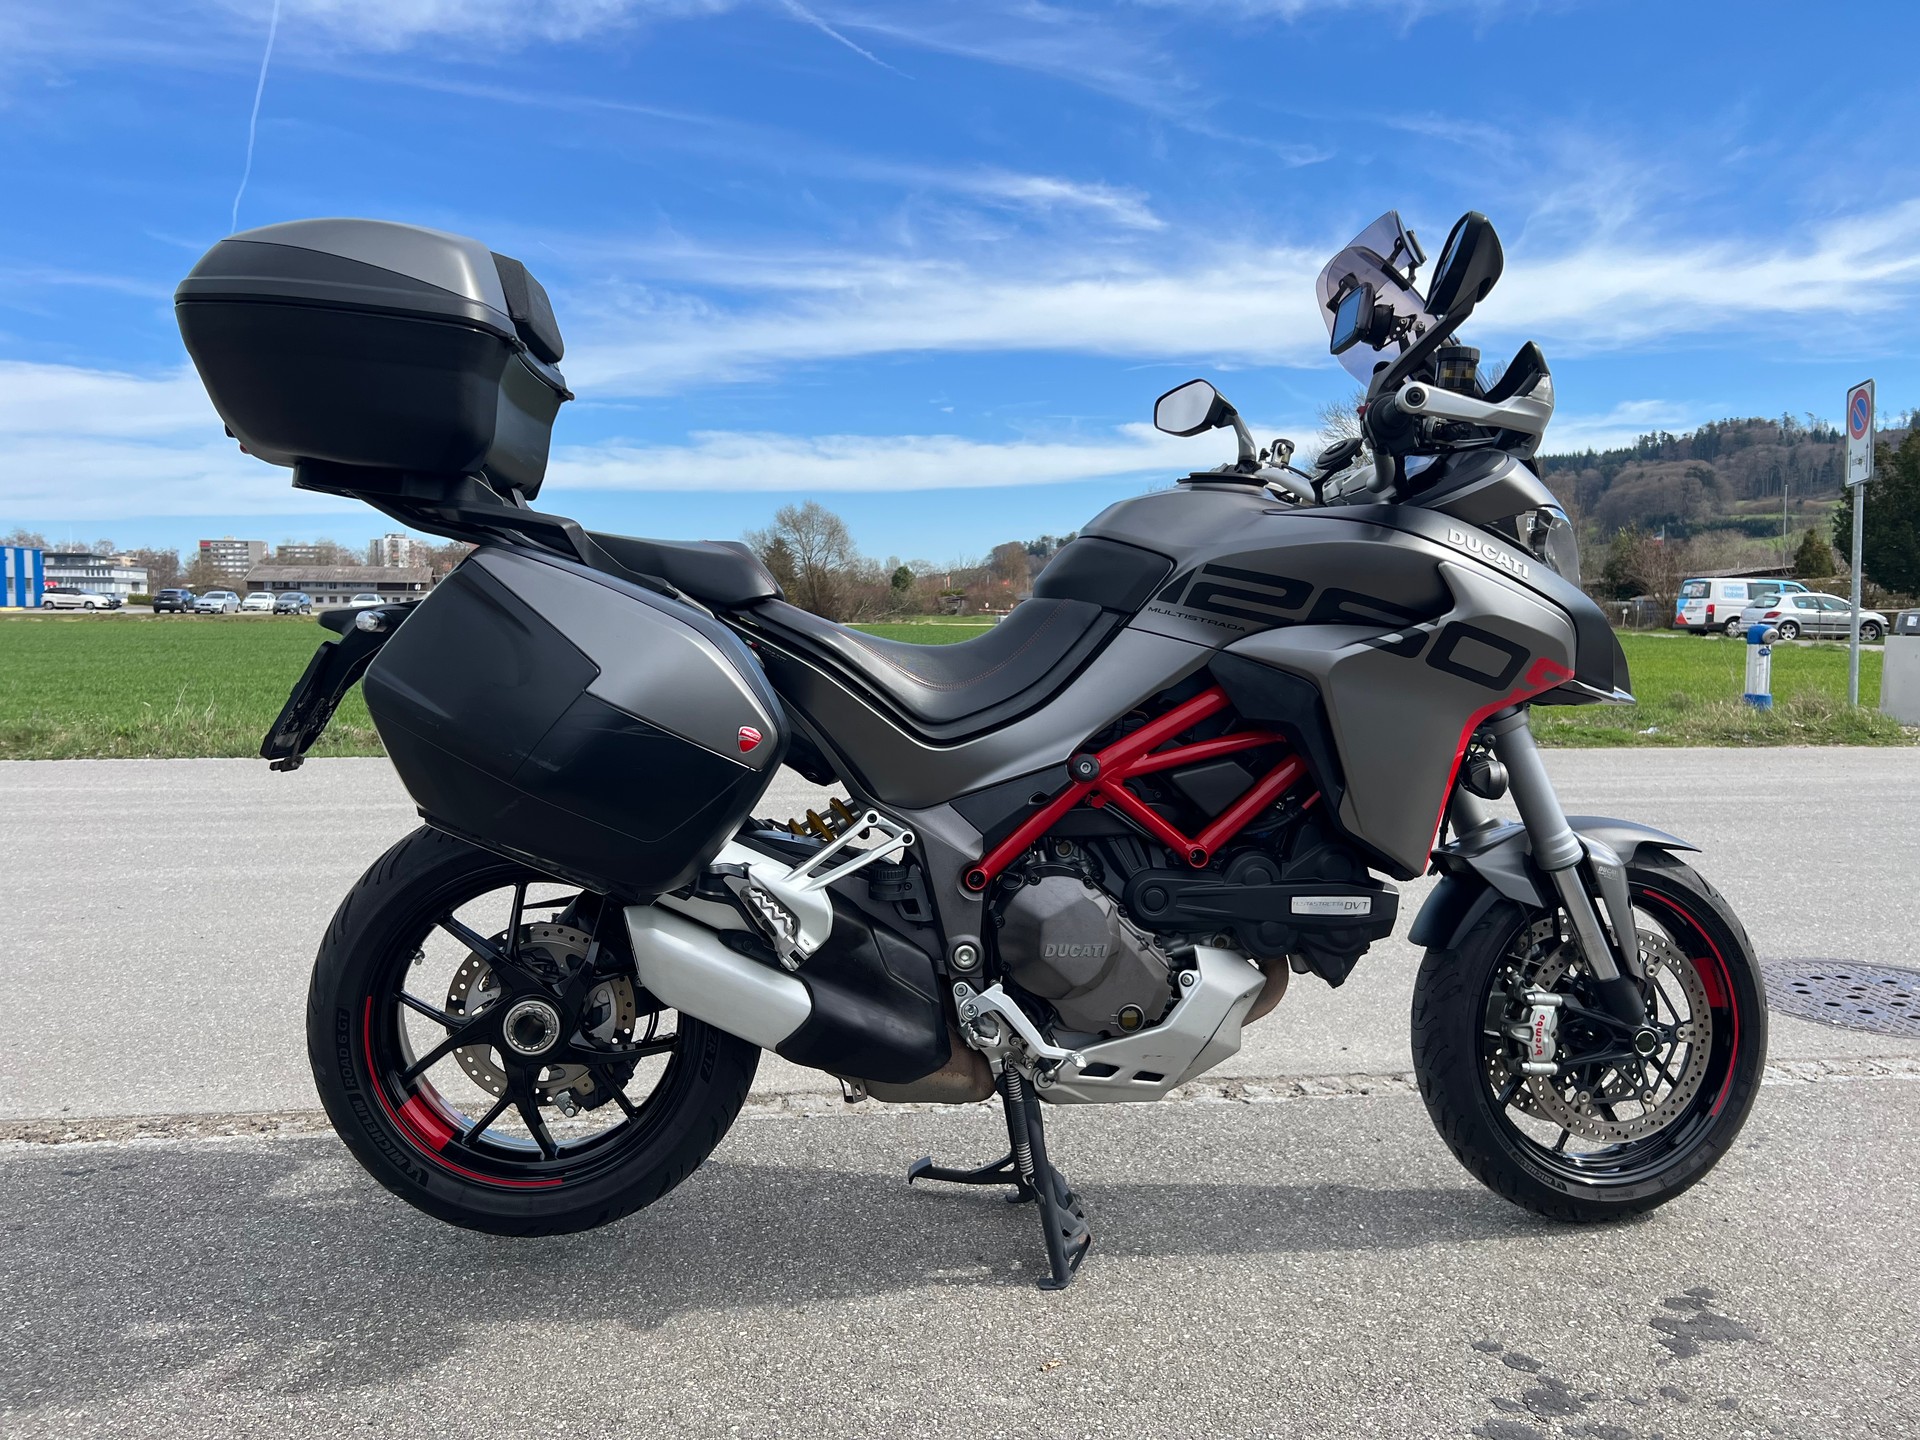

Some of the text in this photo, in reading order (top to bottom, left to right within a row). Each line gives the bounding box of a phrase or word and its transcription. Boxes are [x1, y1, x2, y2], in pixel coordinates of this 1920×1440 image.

[1448, 528, 1529, 579] DUCATI
[1148, 606, 1246, 633] MULTISTRADA
[1344, 901, 1370, 910] DVT
[1044, 943, 1108, 958] DUCATI
[338, 1012, 350, 1032] GT
[1534, 1014, 1546, 1056] brembo
[338, 1048, 357, 1088] ROAD
[703, 1030, 718, 1078] ZR 17
[351, 1097, 409, 1167] MICHELIN
[1513, 1152, 1554, 1185] MICHELIN
